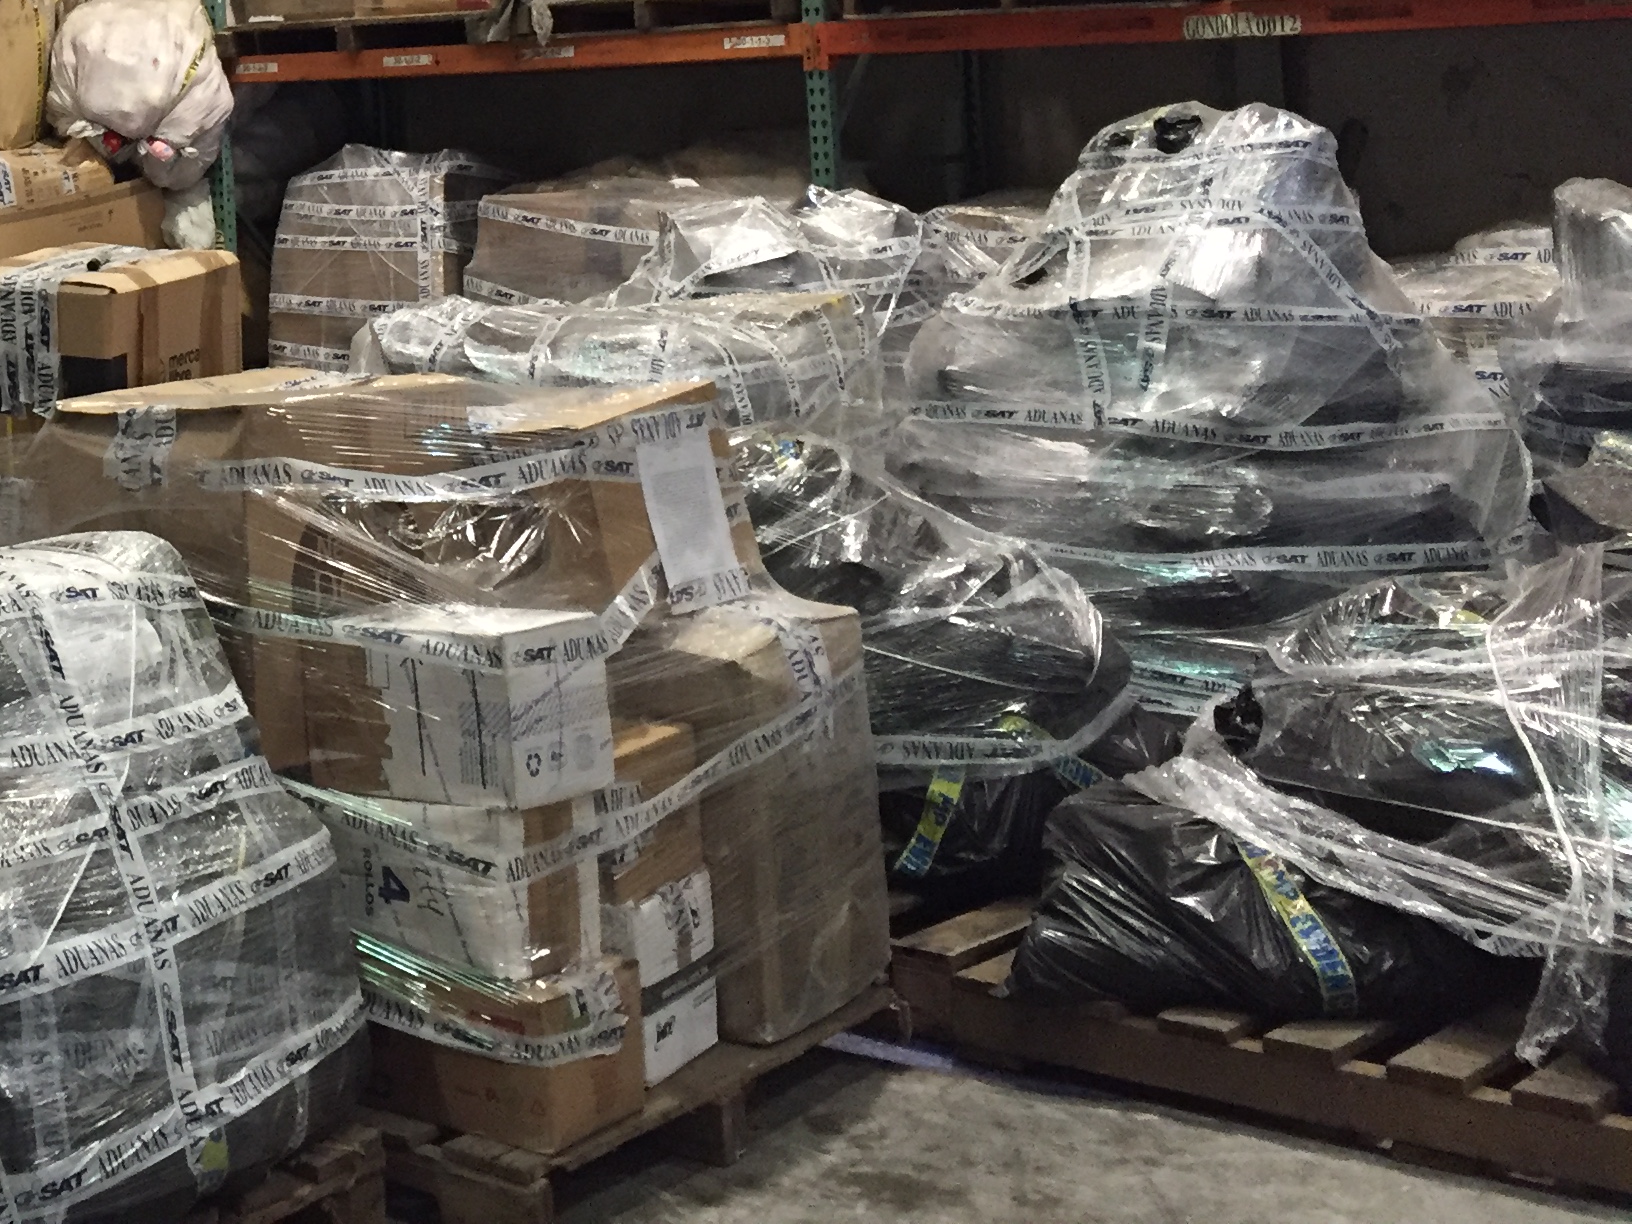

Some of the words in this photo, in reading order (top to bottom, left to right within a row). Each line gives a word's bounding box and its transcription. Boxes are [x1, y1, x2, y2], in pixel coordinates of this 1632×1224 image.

[1186, 13, 1300, 37] GONDOLA0012
[333, 208, 353, 216] SAT
[1179, 198, 1246, 211] ADUANAS
[521, 215, 542, 225] SAT
[588, 227, 611, 237] SAT
[328, 239, 348, 248] SAT
[1497, 251, 1532, 262] SAT
[494, 289, 515, 300] SAT
[304, 300, 324, 309] SAT
[368, 303, 390, 312] SAT
[1242, 308, 1296, 323] ADUANAS
[1452, 303, 1487, 315] SAT
[168, 348, 200, 367] merca
[1024, 410, 1084, 425] ADUANAS
[1150, 419, 1217, 442] ADUANAS
[220, 456, 294, 486] ADUANAS
[516, 447, 588, 484] ADUANAS
[604, 460, 635, 474] SAT
[1276, 553, 1309, 565] SAT
[1316, 548, 1368, 567] ADUANAS
[1384, 550, 1417, 563] SAT
[65, 586, 100, 599] SAT
[253, 610, 335, 638] ADUANAS
[420, 636, 504, 669] ADUANAS
[523, 645, 556, 663] SAT
[109, 729, 146, 748] SAT
[902, 741, 975, 761] ADUANAS
[363, 847, 374, 917] ROLLOS
[378, 865, 410, 905] 4
[188, 879, 248, 927] ADUANAS
[262, 863, 292, 888] SAT
[56, 933, 129, 979] ADUANAS
[285, 1042, 312, 1066] SAT
[40, 1168, 87, 1201] SAT
[95, 1127, 169, 1183] ADUANAS
